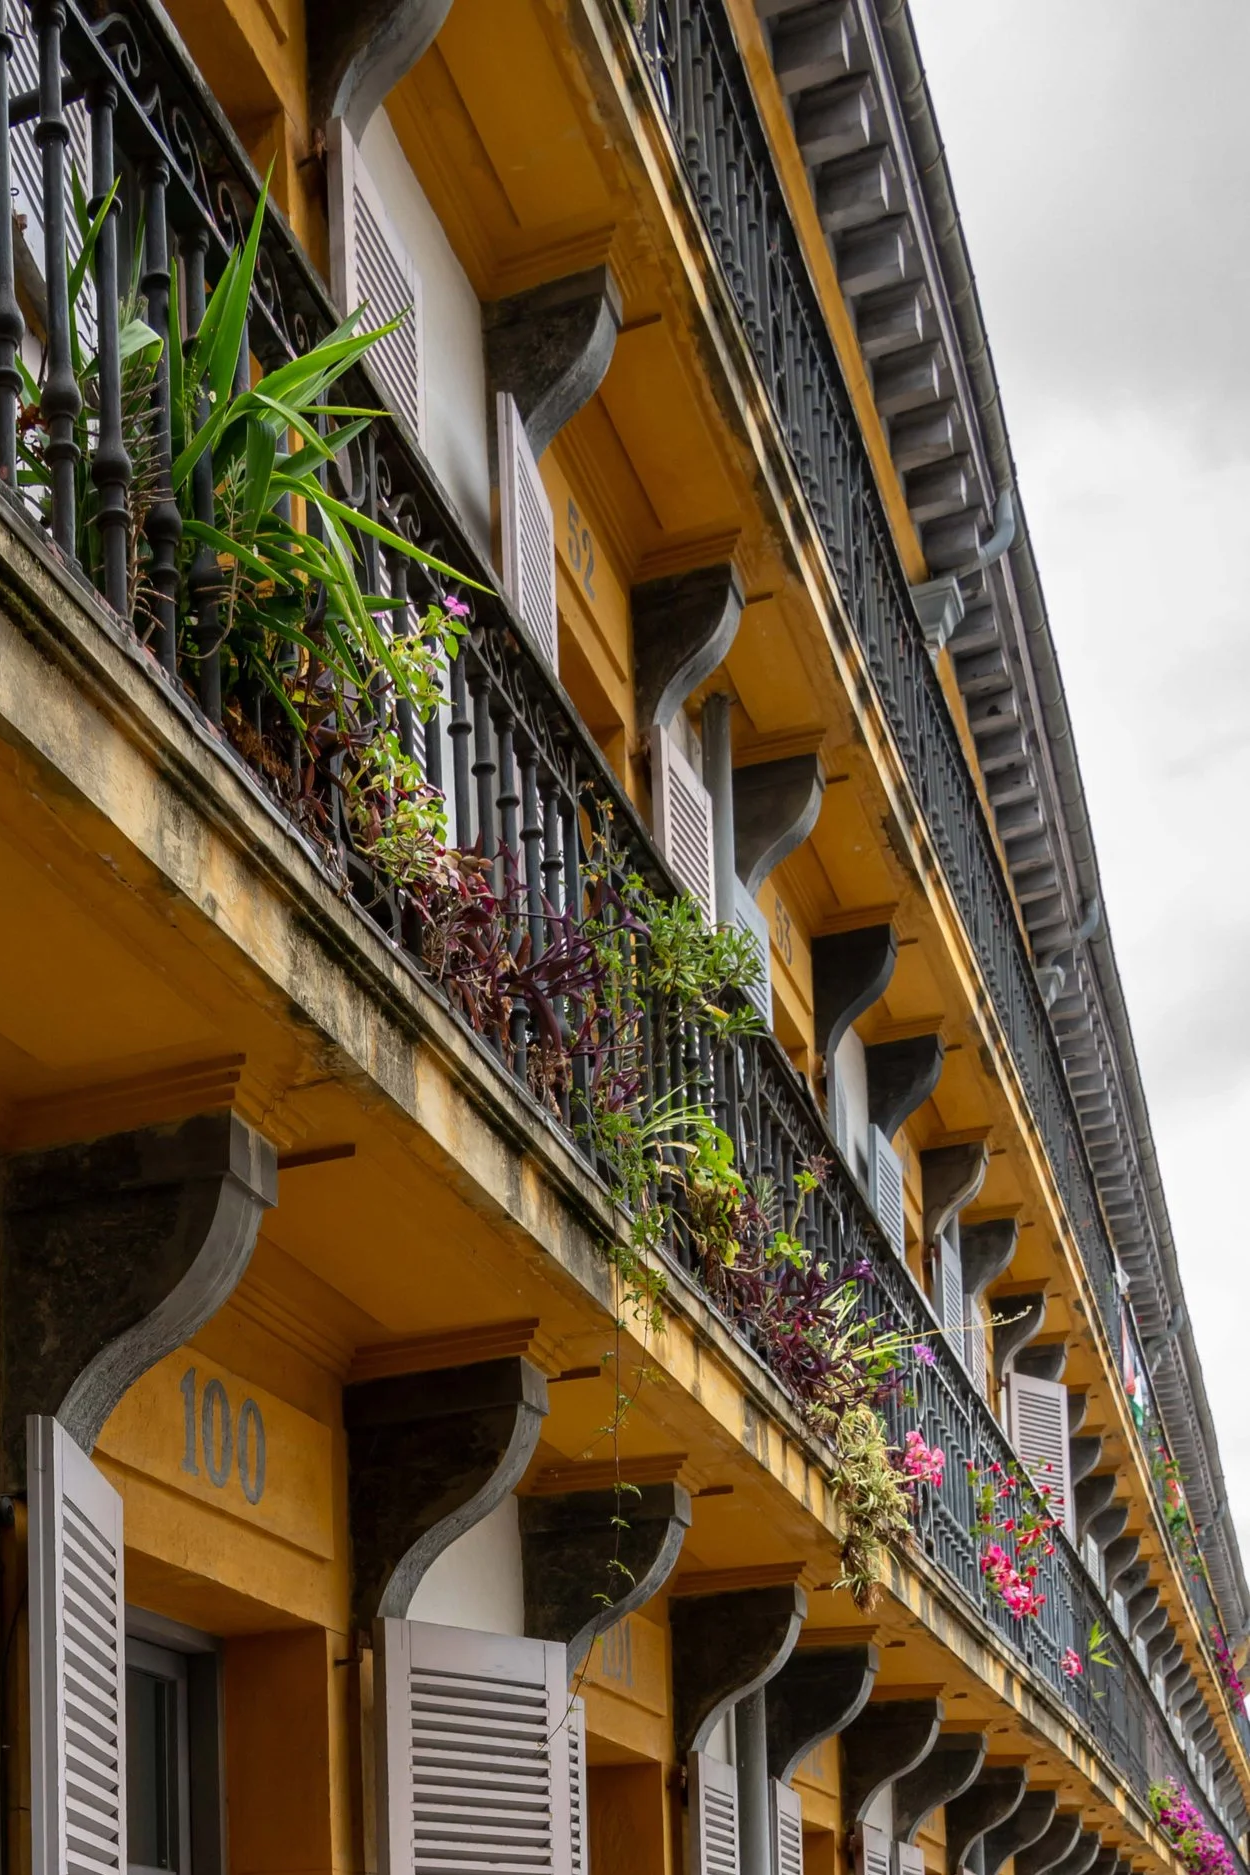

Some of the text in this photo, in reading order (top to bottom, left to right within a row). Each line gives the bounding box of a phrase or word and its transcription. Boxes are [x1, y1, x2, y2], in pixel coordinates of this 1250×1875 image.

[567, 496, 596, 602] 52
[775, 894, 792, 967] 53
[180, 1366, 267, 1506] 100
